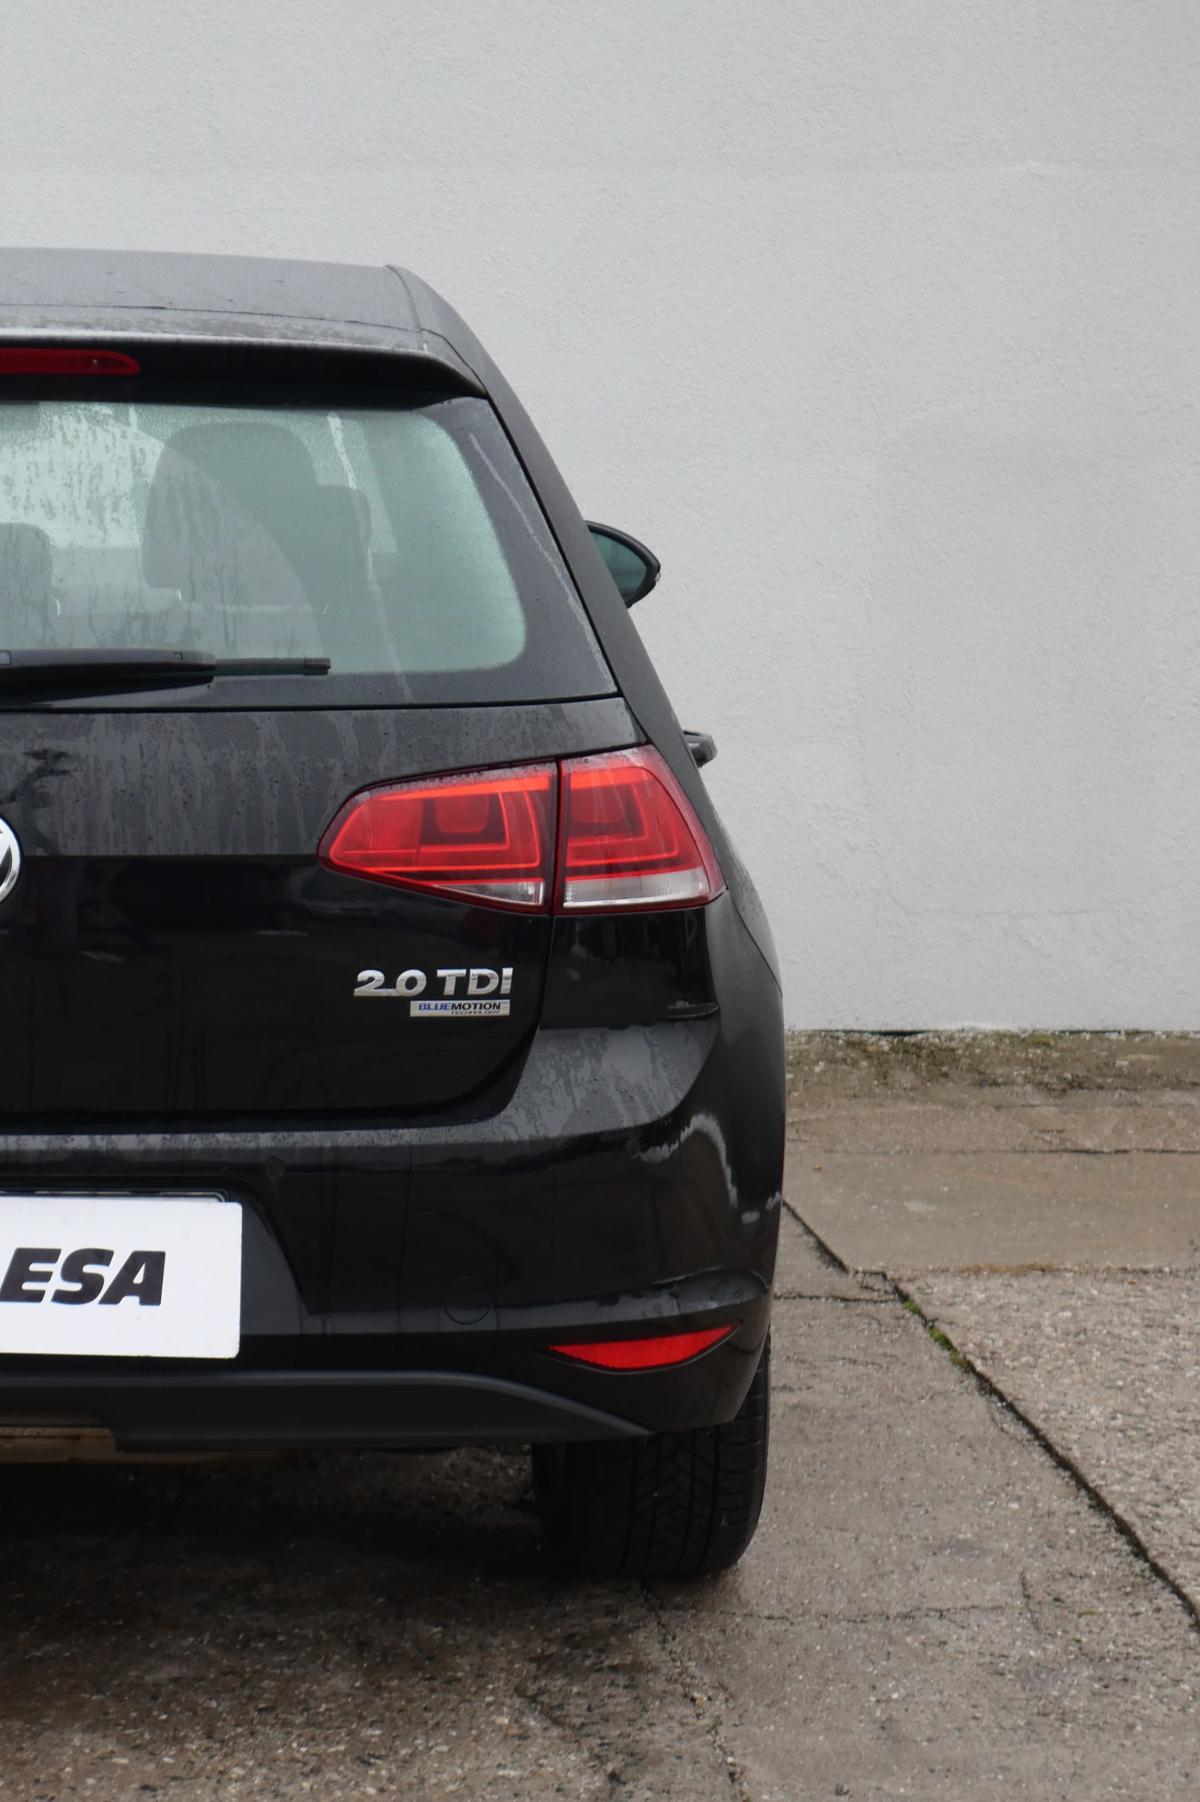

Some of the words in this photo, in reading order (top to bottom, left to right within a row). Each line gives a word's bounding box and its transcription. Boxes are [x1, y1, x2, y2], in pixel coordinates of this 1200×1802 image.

[353, 969, 427, 997] 2.0
[436, 967, 514, 996] TDI
[418, 1002, 501, 1011] BLUEMOTION
